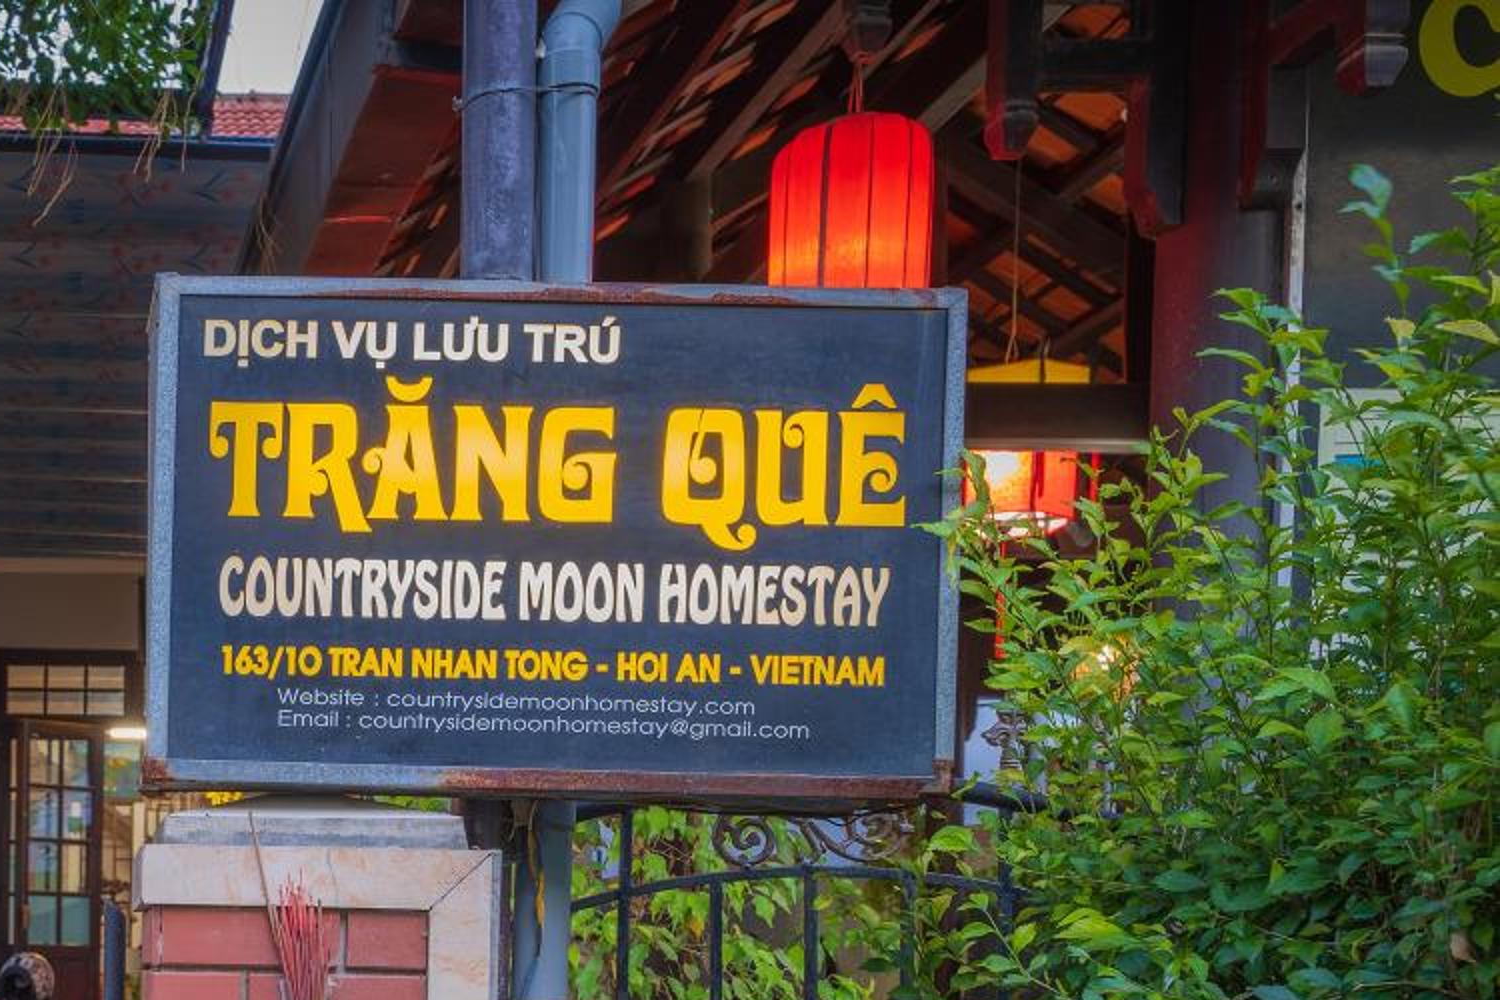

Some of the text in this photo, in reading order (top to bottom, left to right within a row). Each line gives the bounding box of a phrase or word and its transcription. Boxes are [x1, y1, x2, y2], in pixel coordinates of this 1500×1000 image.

[204, 316, 622, 369] DỊCH VỤ LƯU TRÚ
[209, 375, 906, 551] TRĂNG QUÊ
[219, 555, 891, 627] COUNTRYSIDE MOON HOMESTAY
[221, 645, 323, 680] 163/10
[328, 647, 403, 678] TRAN
[411, 648, 498, 680] NHAN
[504, 650, 589, 682] TONG
[616, 651, 669, 683] HOI
[675, 653, 721, 685] AN
[750, 655, 886, 687] VIETNAM
[277, 688, 365, 706] Website
[387, 690, 756, 717] countrysidemoonhomestay.com
[277, 709, 340, 728] Email
[359, 712, 810, 741] countrysidemoonhomestay@gmail.com
